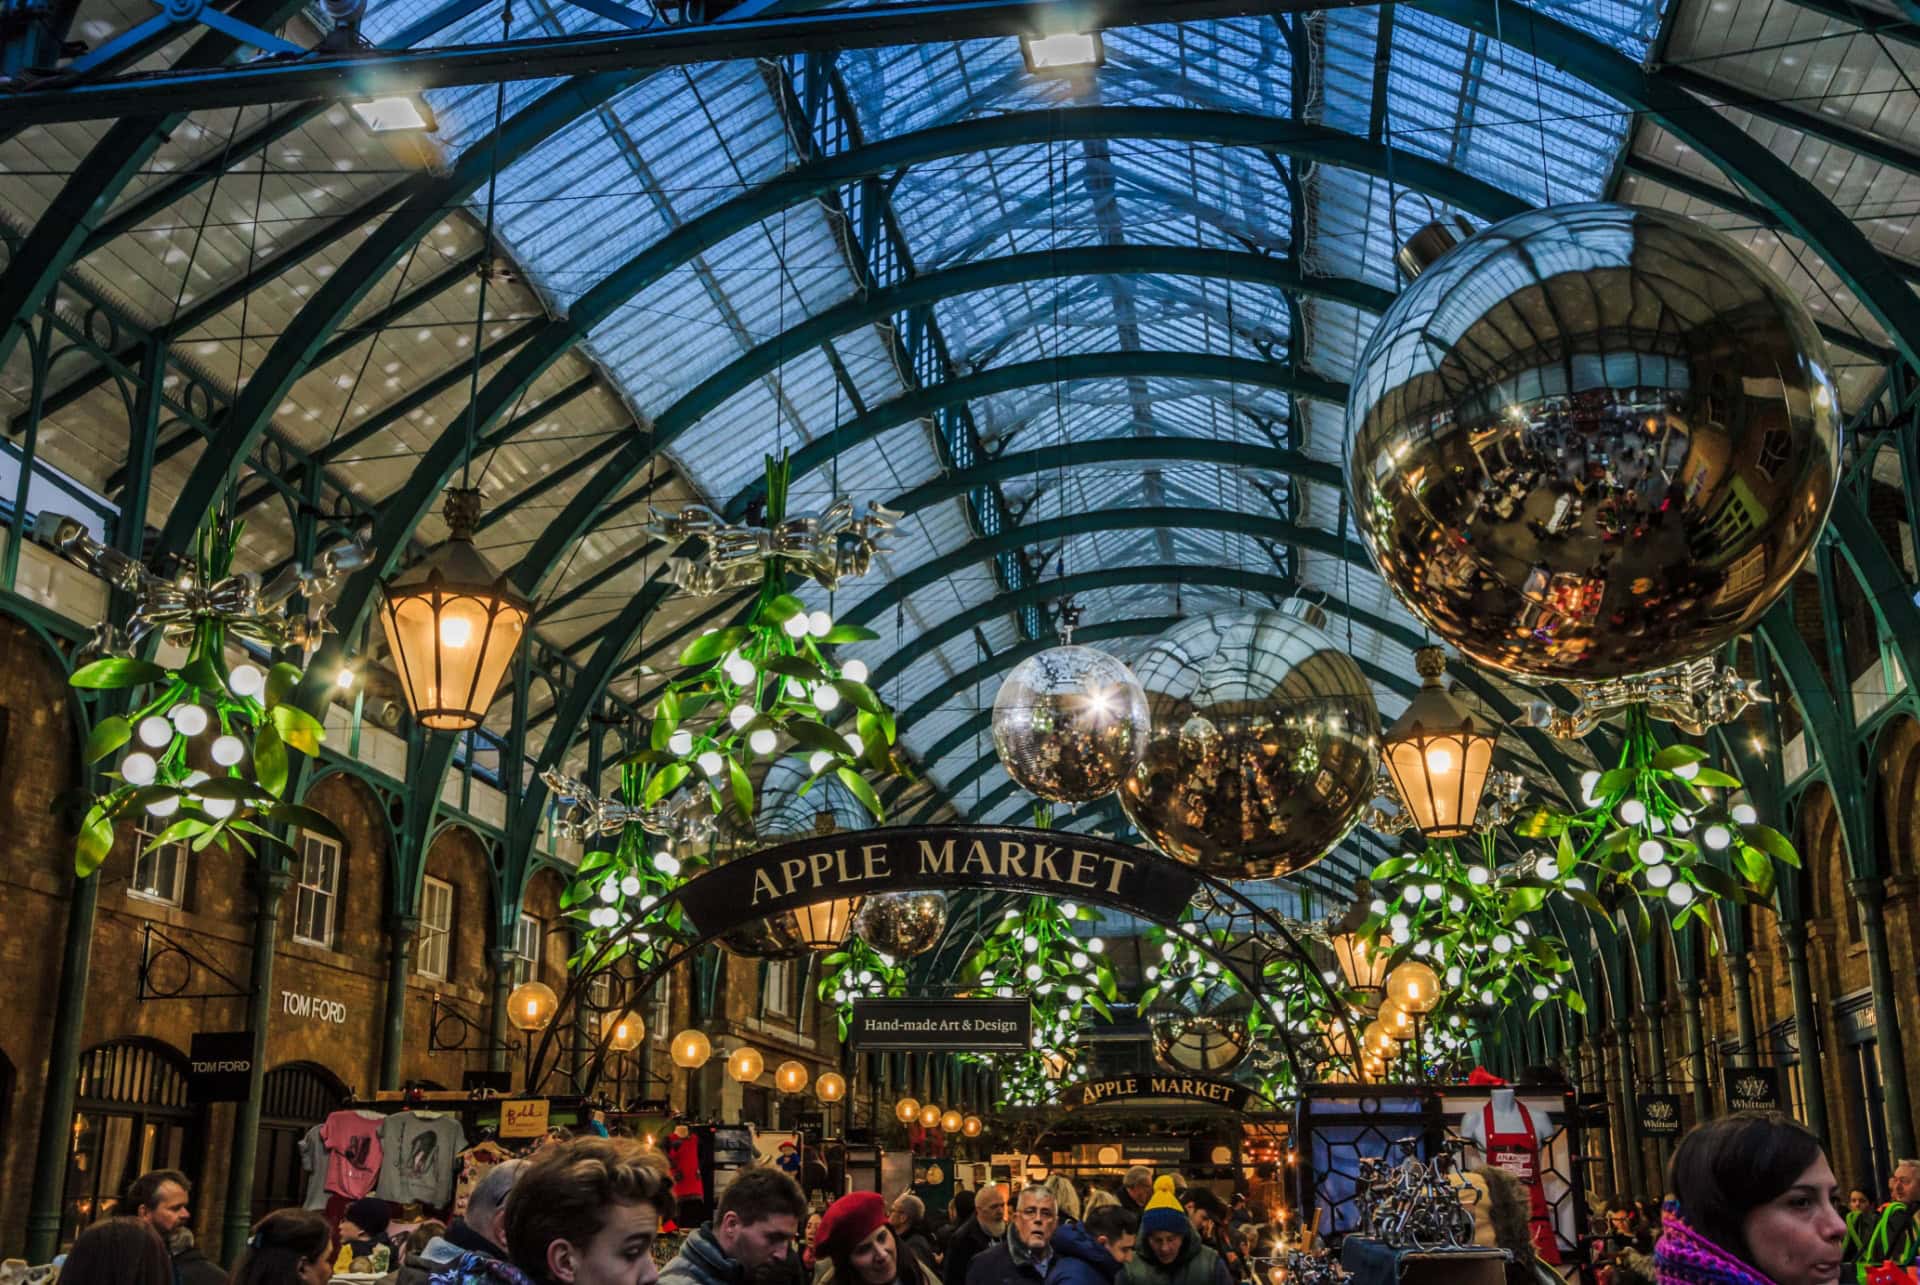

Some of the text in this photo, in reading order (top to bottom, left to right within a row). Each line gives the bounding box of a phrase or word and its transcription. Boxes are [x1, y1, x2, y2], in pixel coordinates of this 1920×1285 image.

[751, 840, 1134, 905] APPLE MARKET
[281, 991, 346, 1023] TOM FORD
[865, 1018, 1017, 1033] Hand-made Art & Design
[192, 1060, 250, 1073] TOM FORD
[1083, 1078, 1235, 1104] APPLE MARKET
